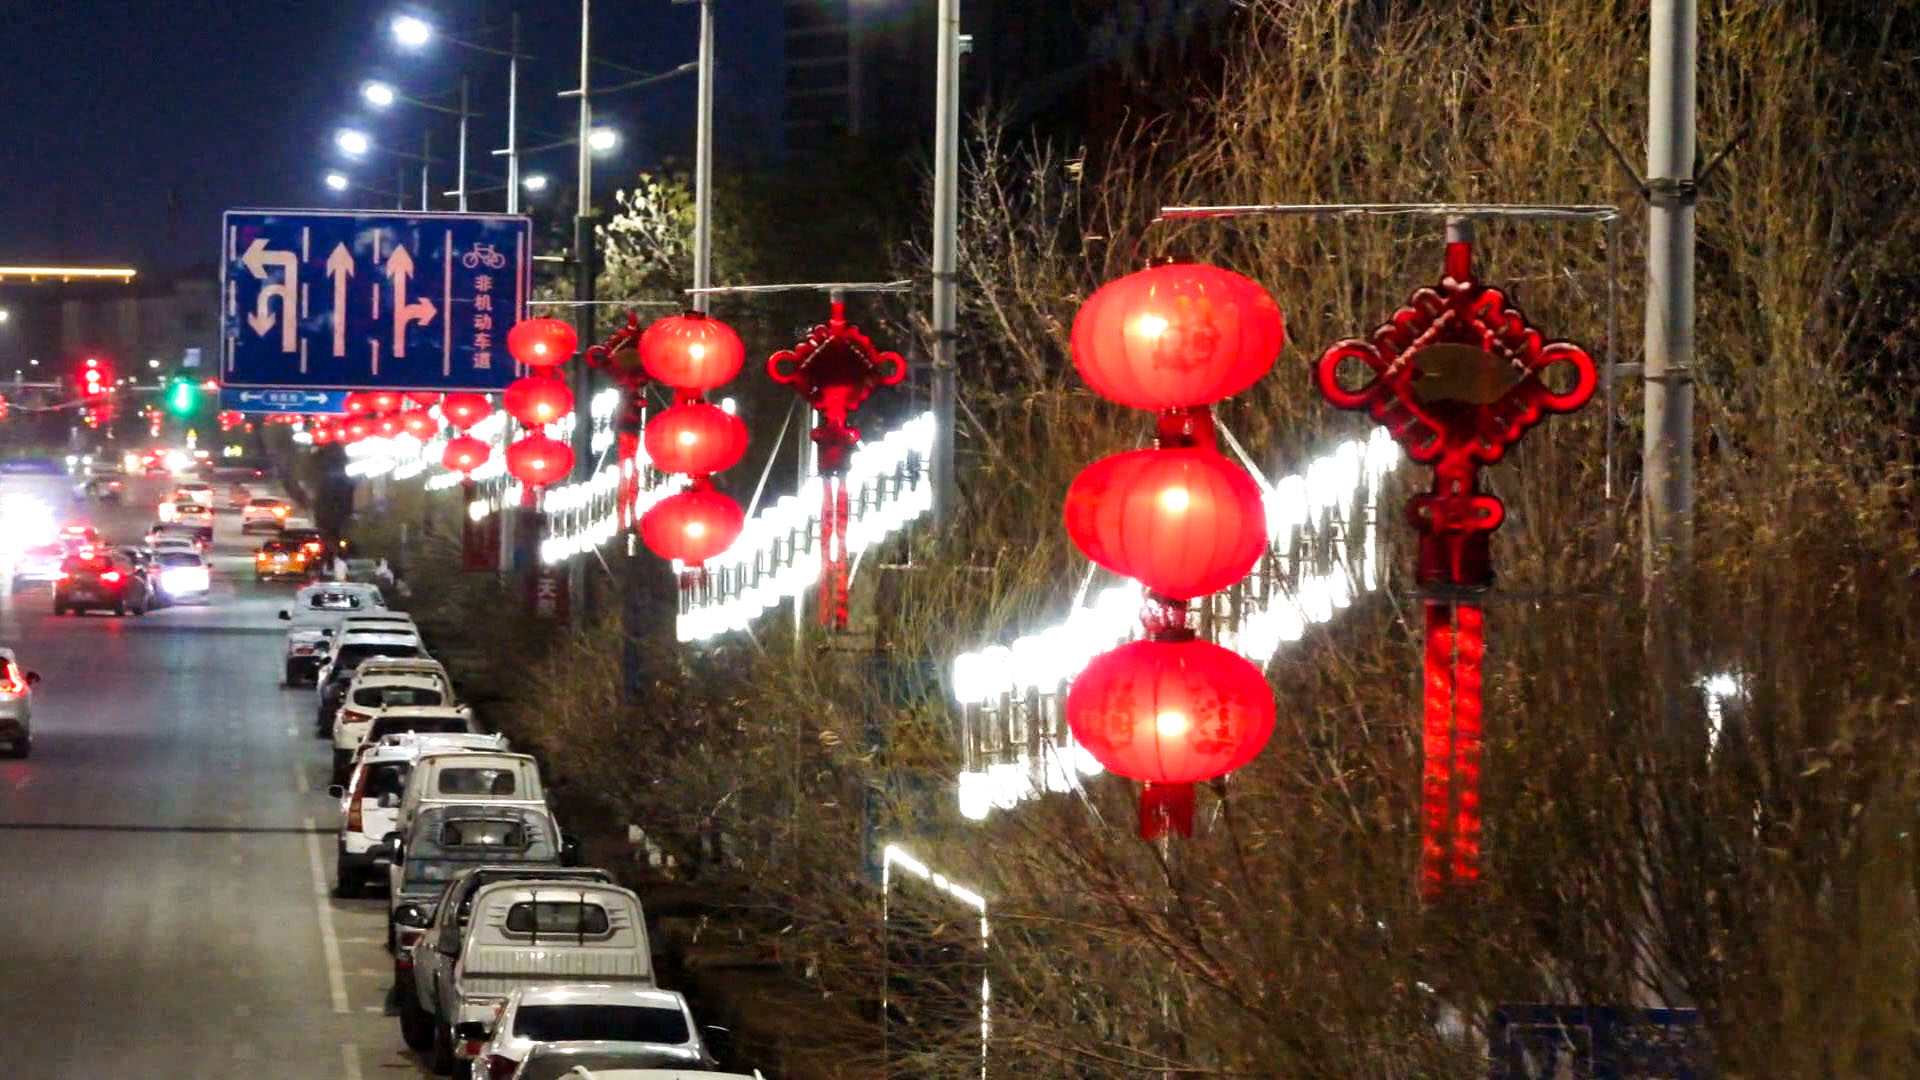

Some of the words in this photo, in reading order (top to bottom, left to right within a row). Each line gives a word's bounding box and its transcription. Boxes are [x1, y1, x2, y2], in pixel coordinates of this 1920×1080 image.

[473, 274, 493, 369] 非机动车道
